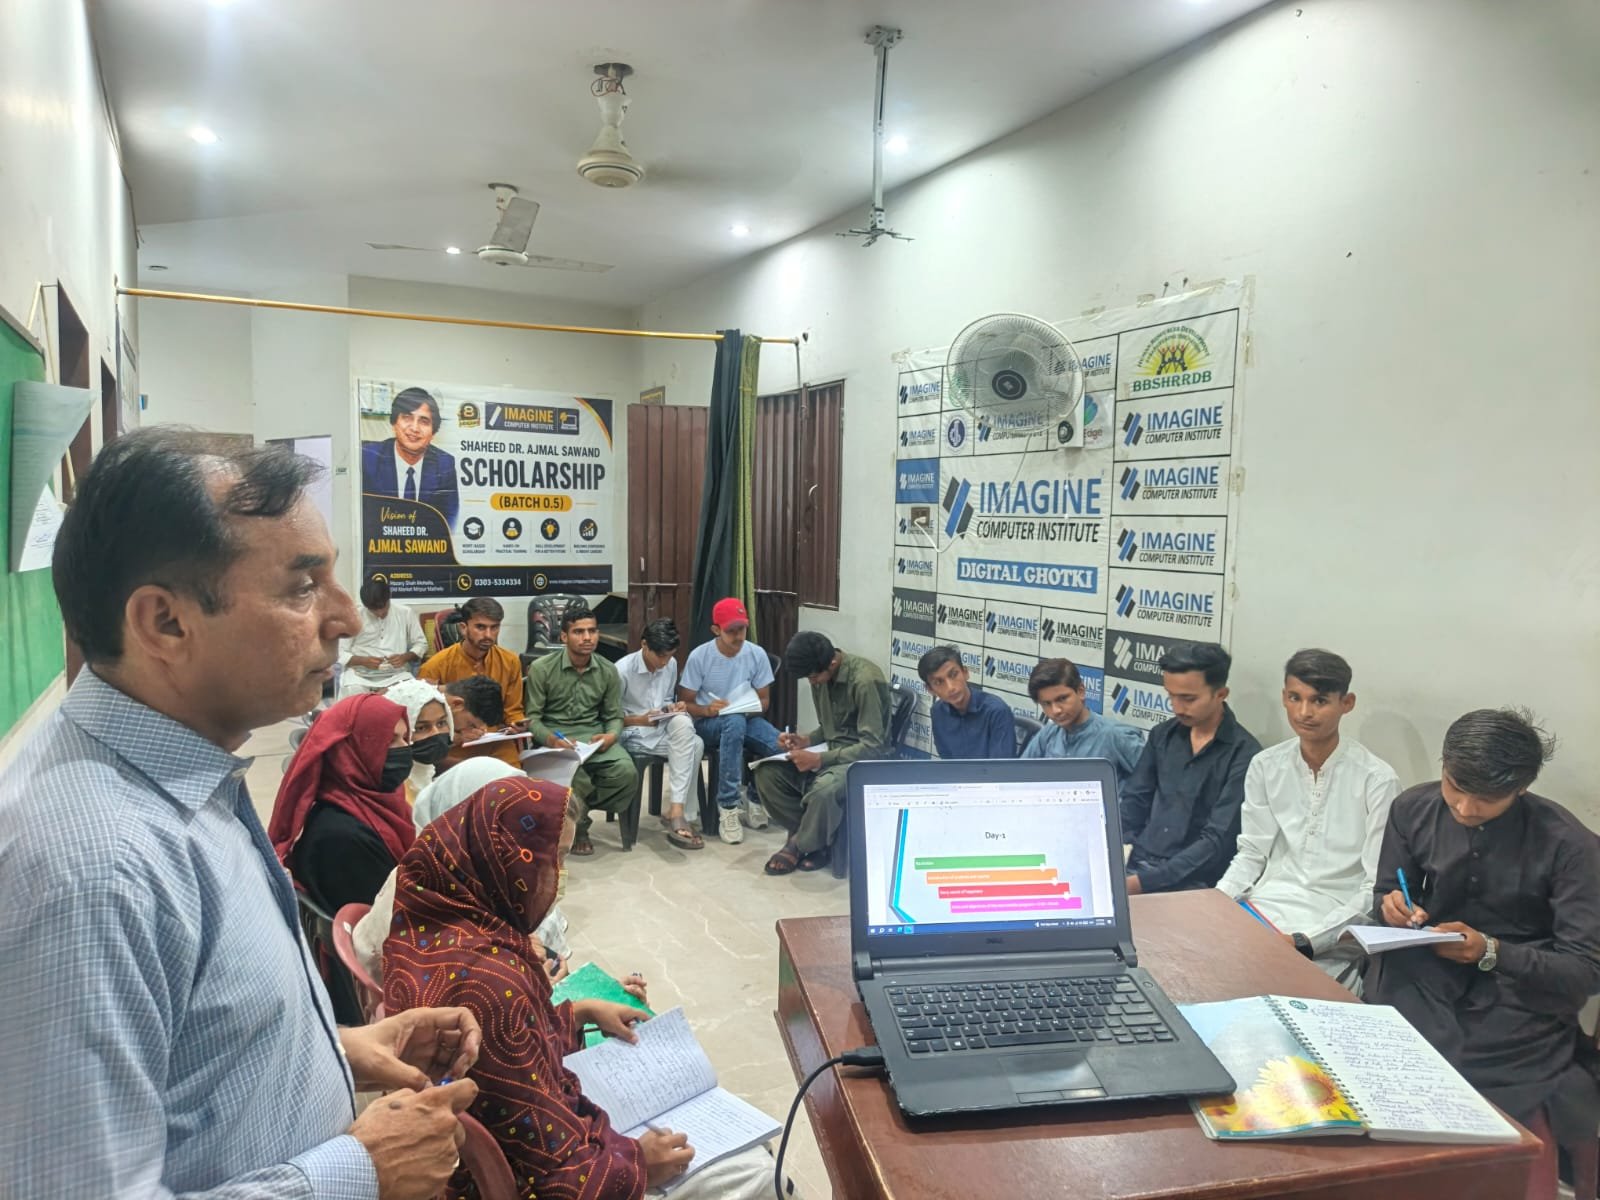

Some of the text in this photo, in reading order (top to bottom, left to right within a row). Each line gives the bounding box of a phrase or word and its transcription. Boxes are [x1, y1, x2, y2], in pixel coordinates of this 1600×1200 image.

[910, 381, 940, 394] IMAGINE
[1132, 370, 1212, 392] BBSHRRDB
[504, 407, 554, 423] IMAGINE
[1147, 406, 1223, 430] IMAGINE
[909, 429, 935, 439] IMAGINE
[1145, 428, 1221, 444] COMPUTER INSTITUTE
[460, 440, 601, 458] SHAHEED DR. AJMAL SAWAND
[460, 457, 606, 490] SCHOLARSHIP
[908, 472, 935, 484] IMAGINE
[1144, 466, 1219, 487] IMAGINE
[979, 478, 1102, 514] IMAGINE
[1142, 488, 1218, 500] COMPUTER INSTITUTE
[499, 496, 564, 510] (BATCH 0.5)
[381, 506, 417, 523] Vision of
[382, 526, 429, 536] SHAHEED DR.
[977, 521, 1100, 542] COMPUTER INSTITUTE
[368, 538, 448, 553] AJMAL SAWAND
[1141, 532, 1216, 552] IMAGINE
[907, 559, 933, 570] IMAGINE
[1139, 553, 1214, 566] COMPUTER INSTITUTE
[960, 561, 1092, 588] DIGITAL GHOTKI
[903, 600, 934, 615] IMAGINE
[1139, 589, 1213, 613] IMAGINE
[948, 606, 983, 622] IMAGINE
[1137, 609, 1212, 627] COMPUTER INSTITUTE
[998, 615, 1038, 631] IMAGINE
[1057, 622, 1104, 640] IMAGINE
[961, 652, 981, 666] GINE
[997, 660, 1033, 676] IMAGIN
[985, 831, 1006, 841] Day-1
